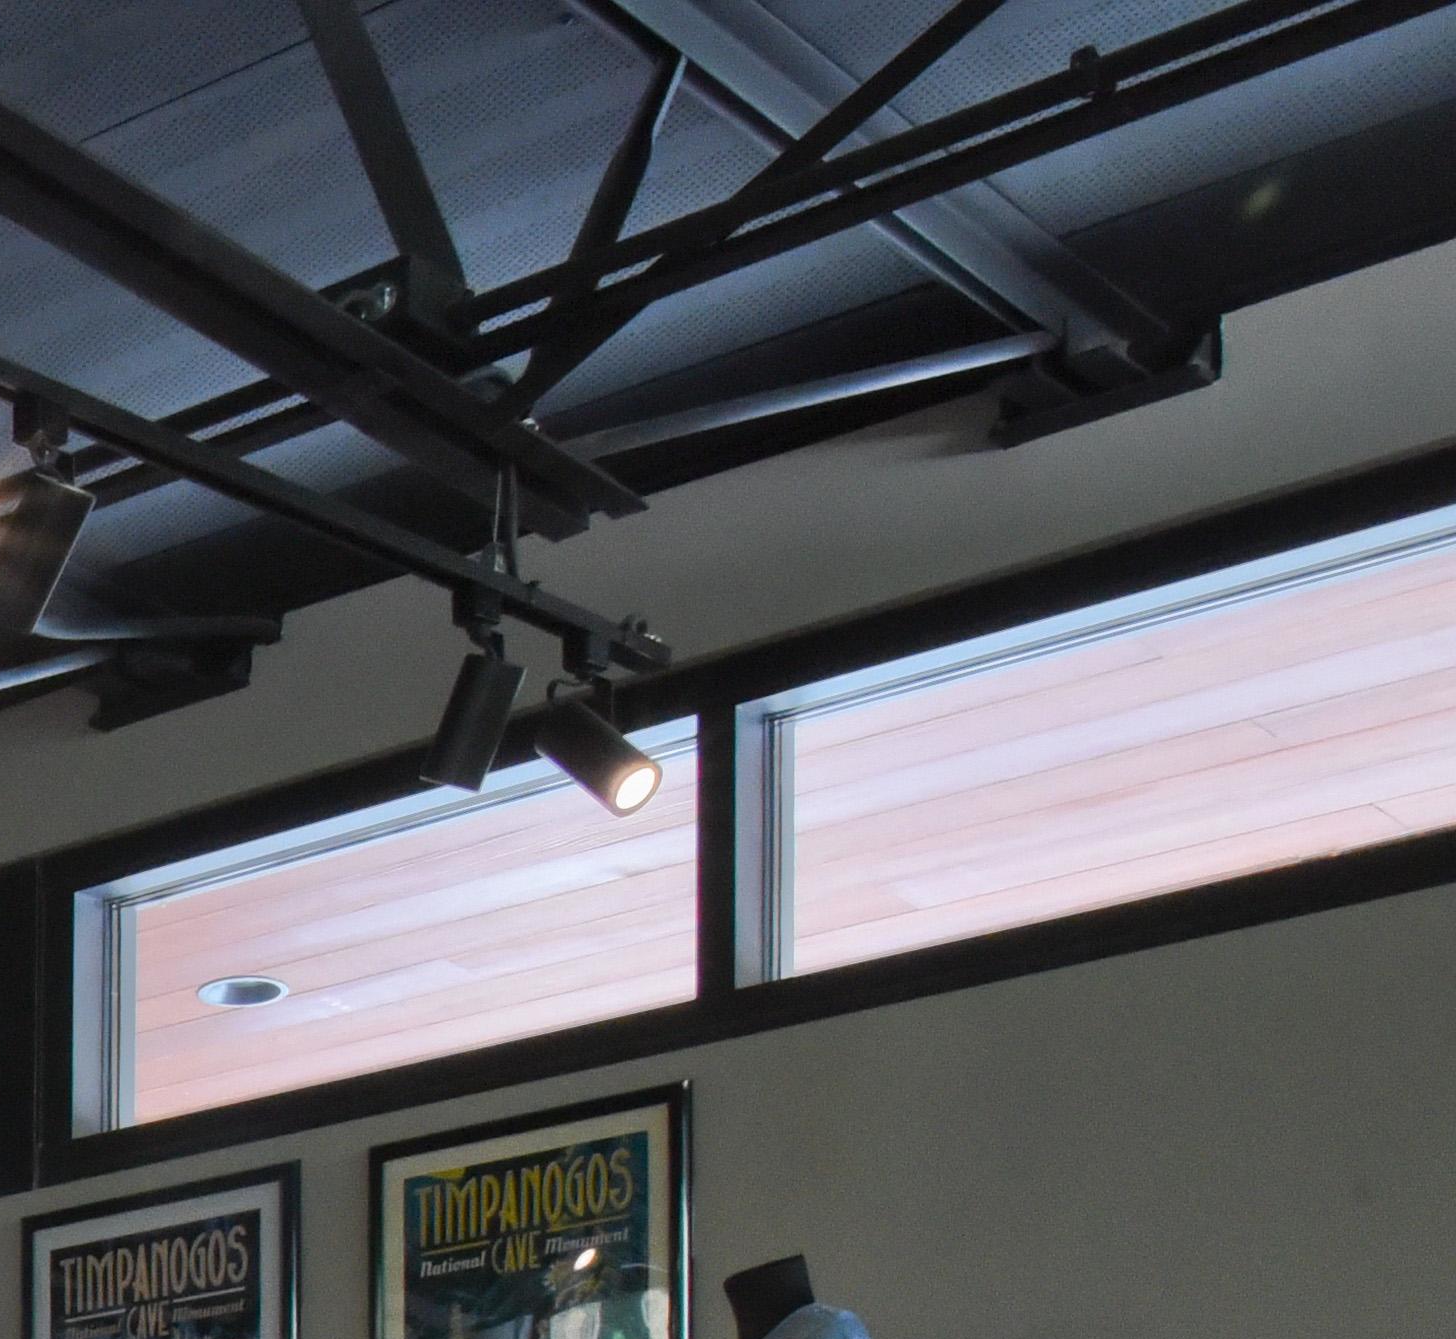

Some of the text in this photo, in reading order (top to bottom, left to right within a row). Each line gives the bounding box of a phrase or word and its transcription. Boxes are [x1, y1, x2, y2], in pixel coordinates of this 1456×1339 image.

[415, 1148, 633, 1247] TIMPANOGOS
[59, 1225, 248, 1315] TIMPANOGOS
[420, 1229, 630, 1278] National CAVE Monument
[127, 1300, 170, 1339] CAVE
